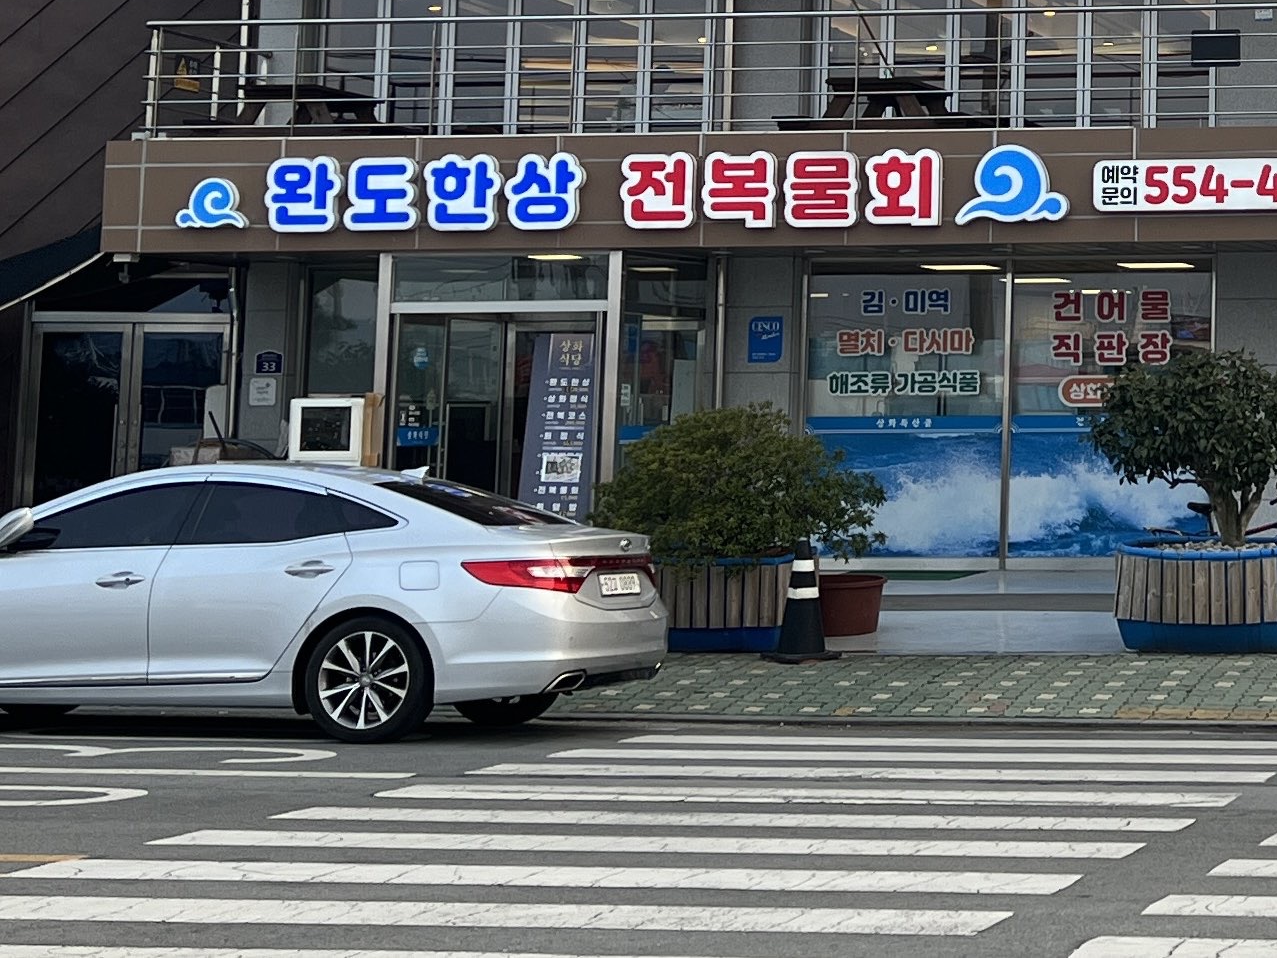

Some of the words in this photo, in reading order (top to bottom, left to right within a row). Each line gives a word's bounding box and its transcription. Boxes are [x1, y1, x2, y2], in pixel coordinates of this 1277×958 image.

[1101, 165, 1139, 184] 예약
[268, 153, 583, 232] 완도한상
[622, 149, 940, 229] 전복물회
[1101, 187, 1138, 206] 문의
[1053, 290, 1171, 322] 건어물
[752, 322, 780, 332] CESCO
[560, 340, 583, 352] 상화
[1052, 331, 1172, 364] 직판장
[261, 362, 276, 372] 33
[560, 353, 581, 366] 식당
[828, 372, 891, 395] 해조류
[896, 371, 980, 394] 가공식품
